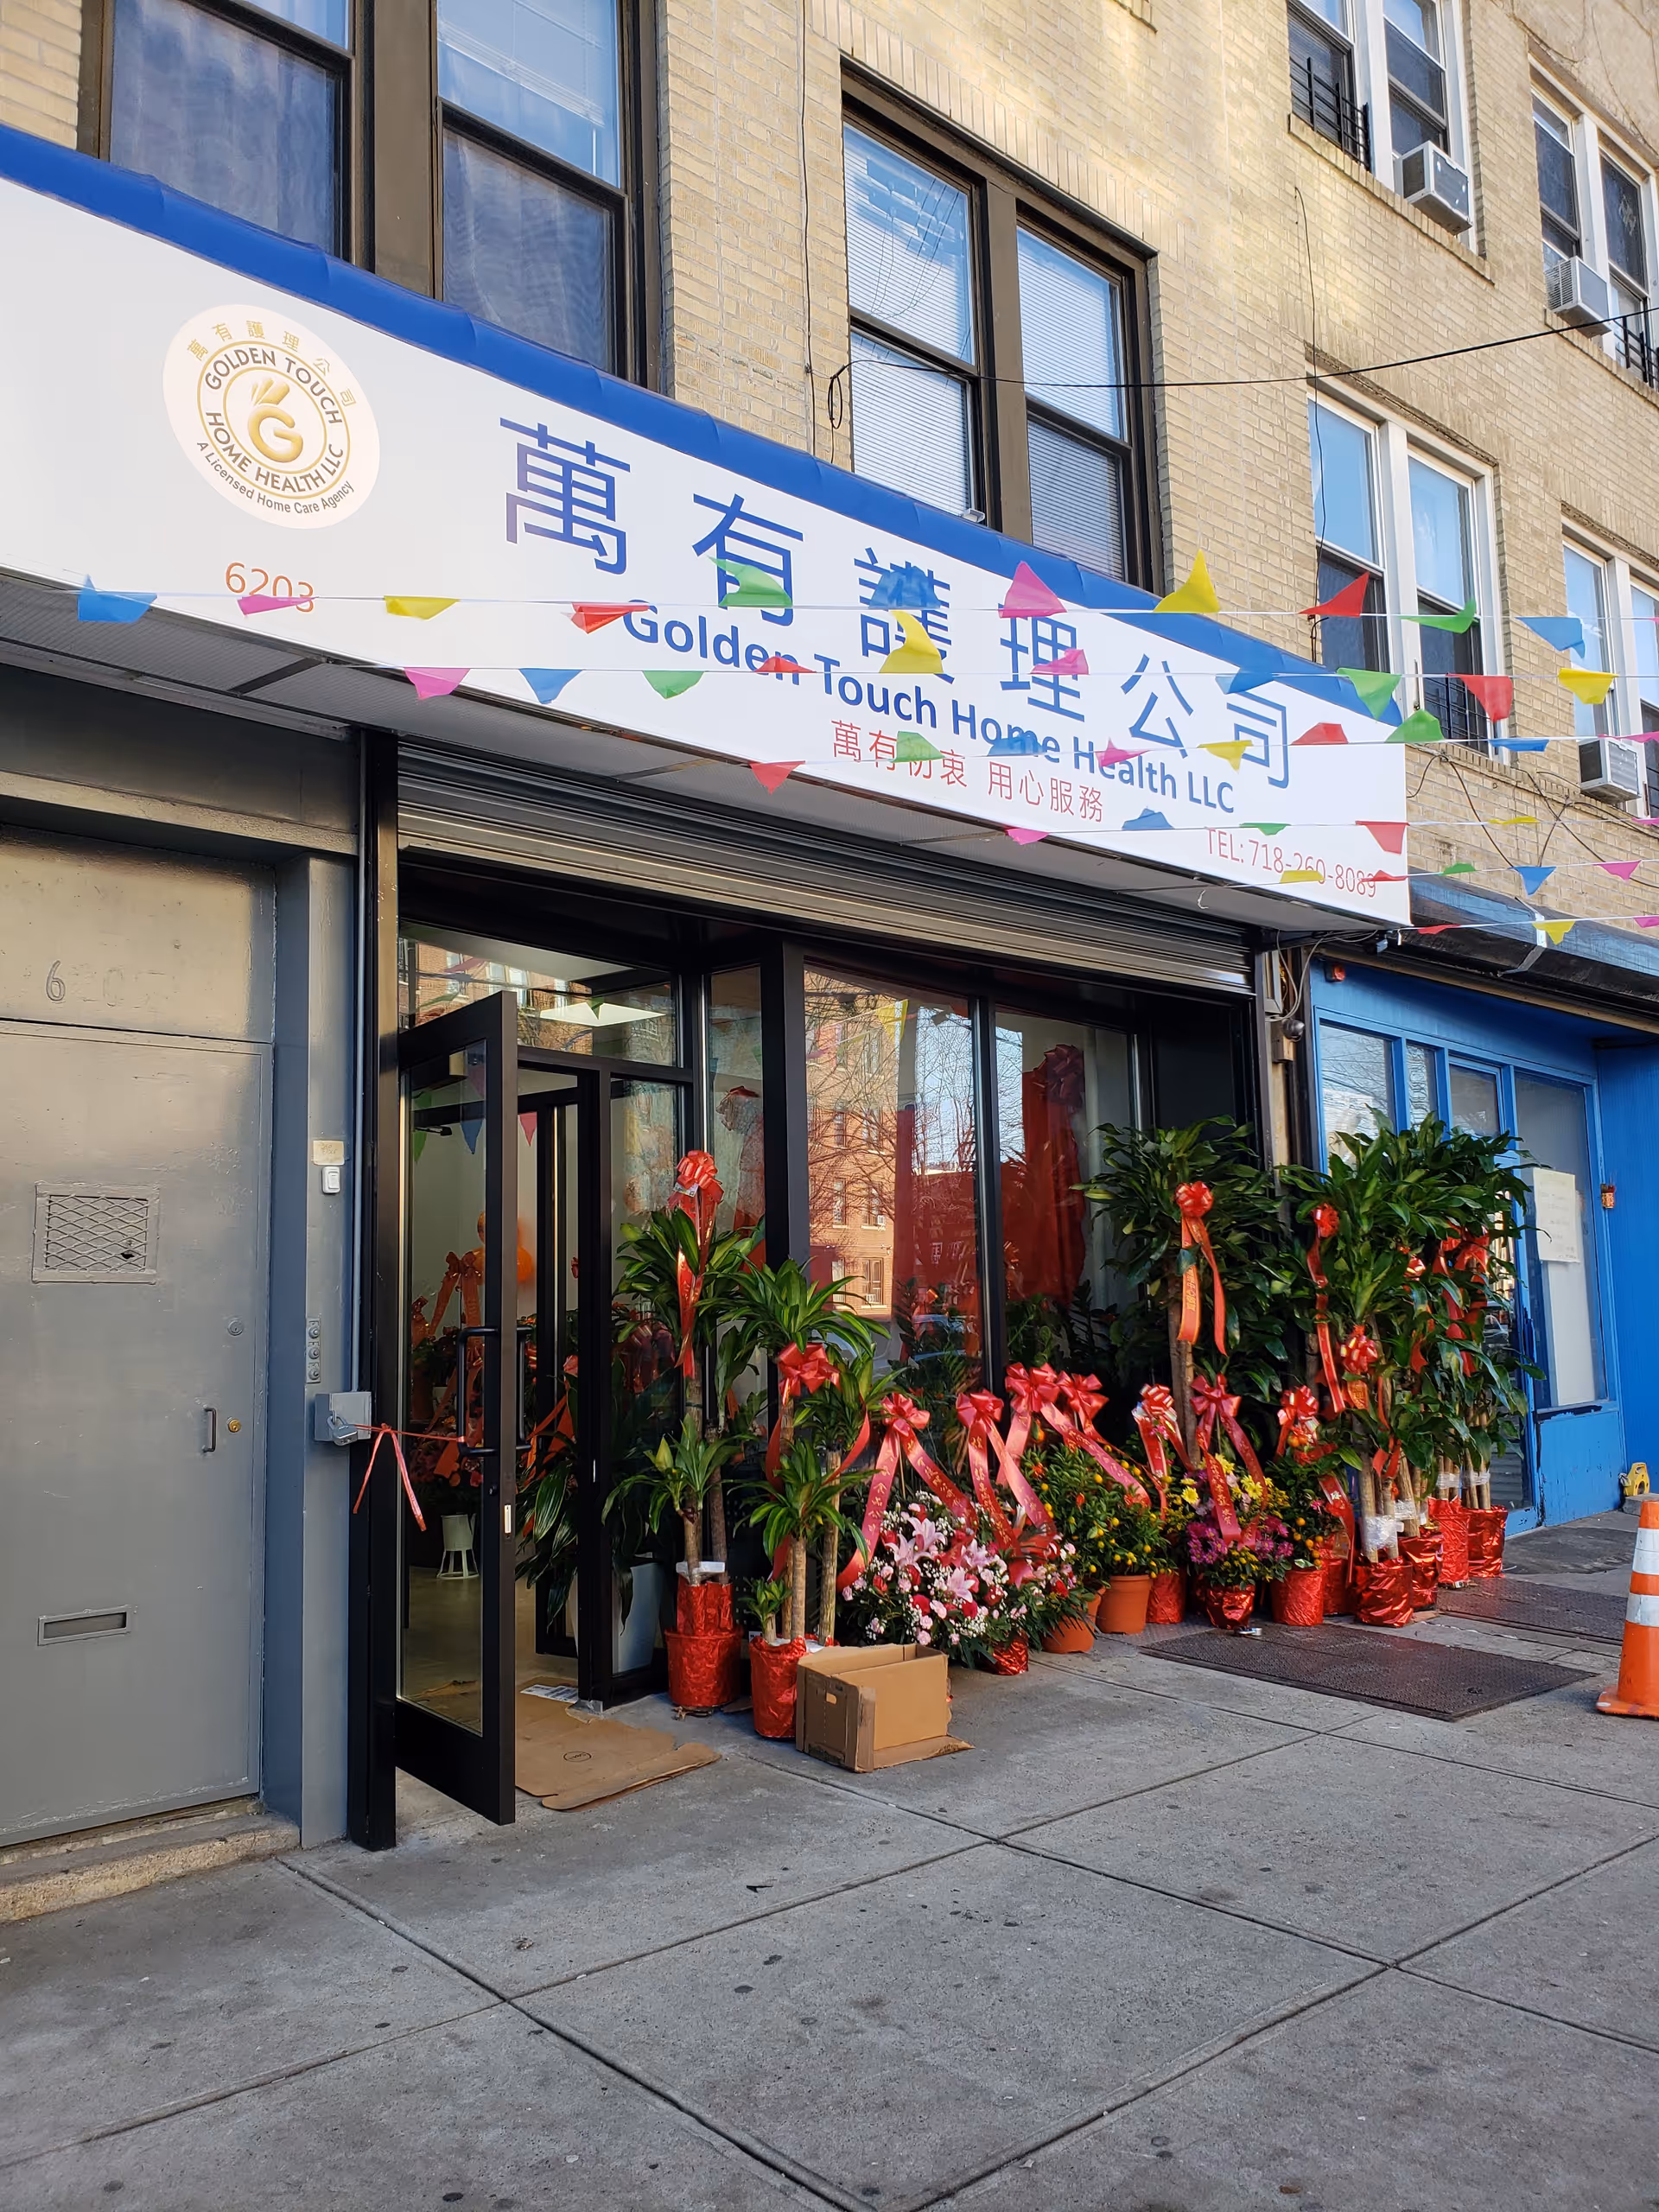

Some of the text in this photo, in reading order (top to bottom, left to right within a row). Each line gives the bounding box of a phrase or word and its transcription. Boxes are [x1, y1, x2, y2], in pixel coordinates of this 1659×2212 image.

[205, 347, 343, 424] GOLDEN TOUCH
[197, 441, 355, 514] A Licensed Home Care Agency
[205, 411, 344, 493] HOME HEALTH LLC
[225, 562, 315, 613] 6203
[623, 600, 800, 686] Golden
[814, 653, 937, 728] Touch
[1072, 735, 1177, 799] Health
[1188, 771, 1234, 813] LLC
[988, 760, 1103, 823] 用心服務
